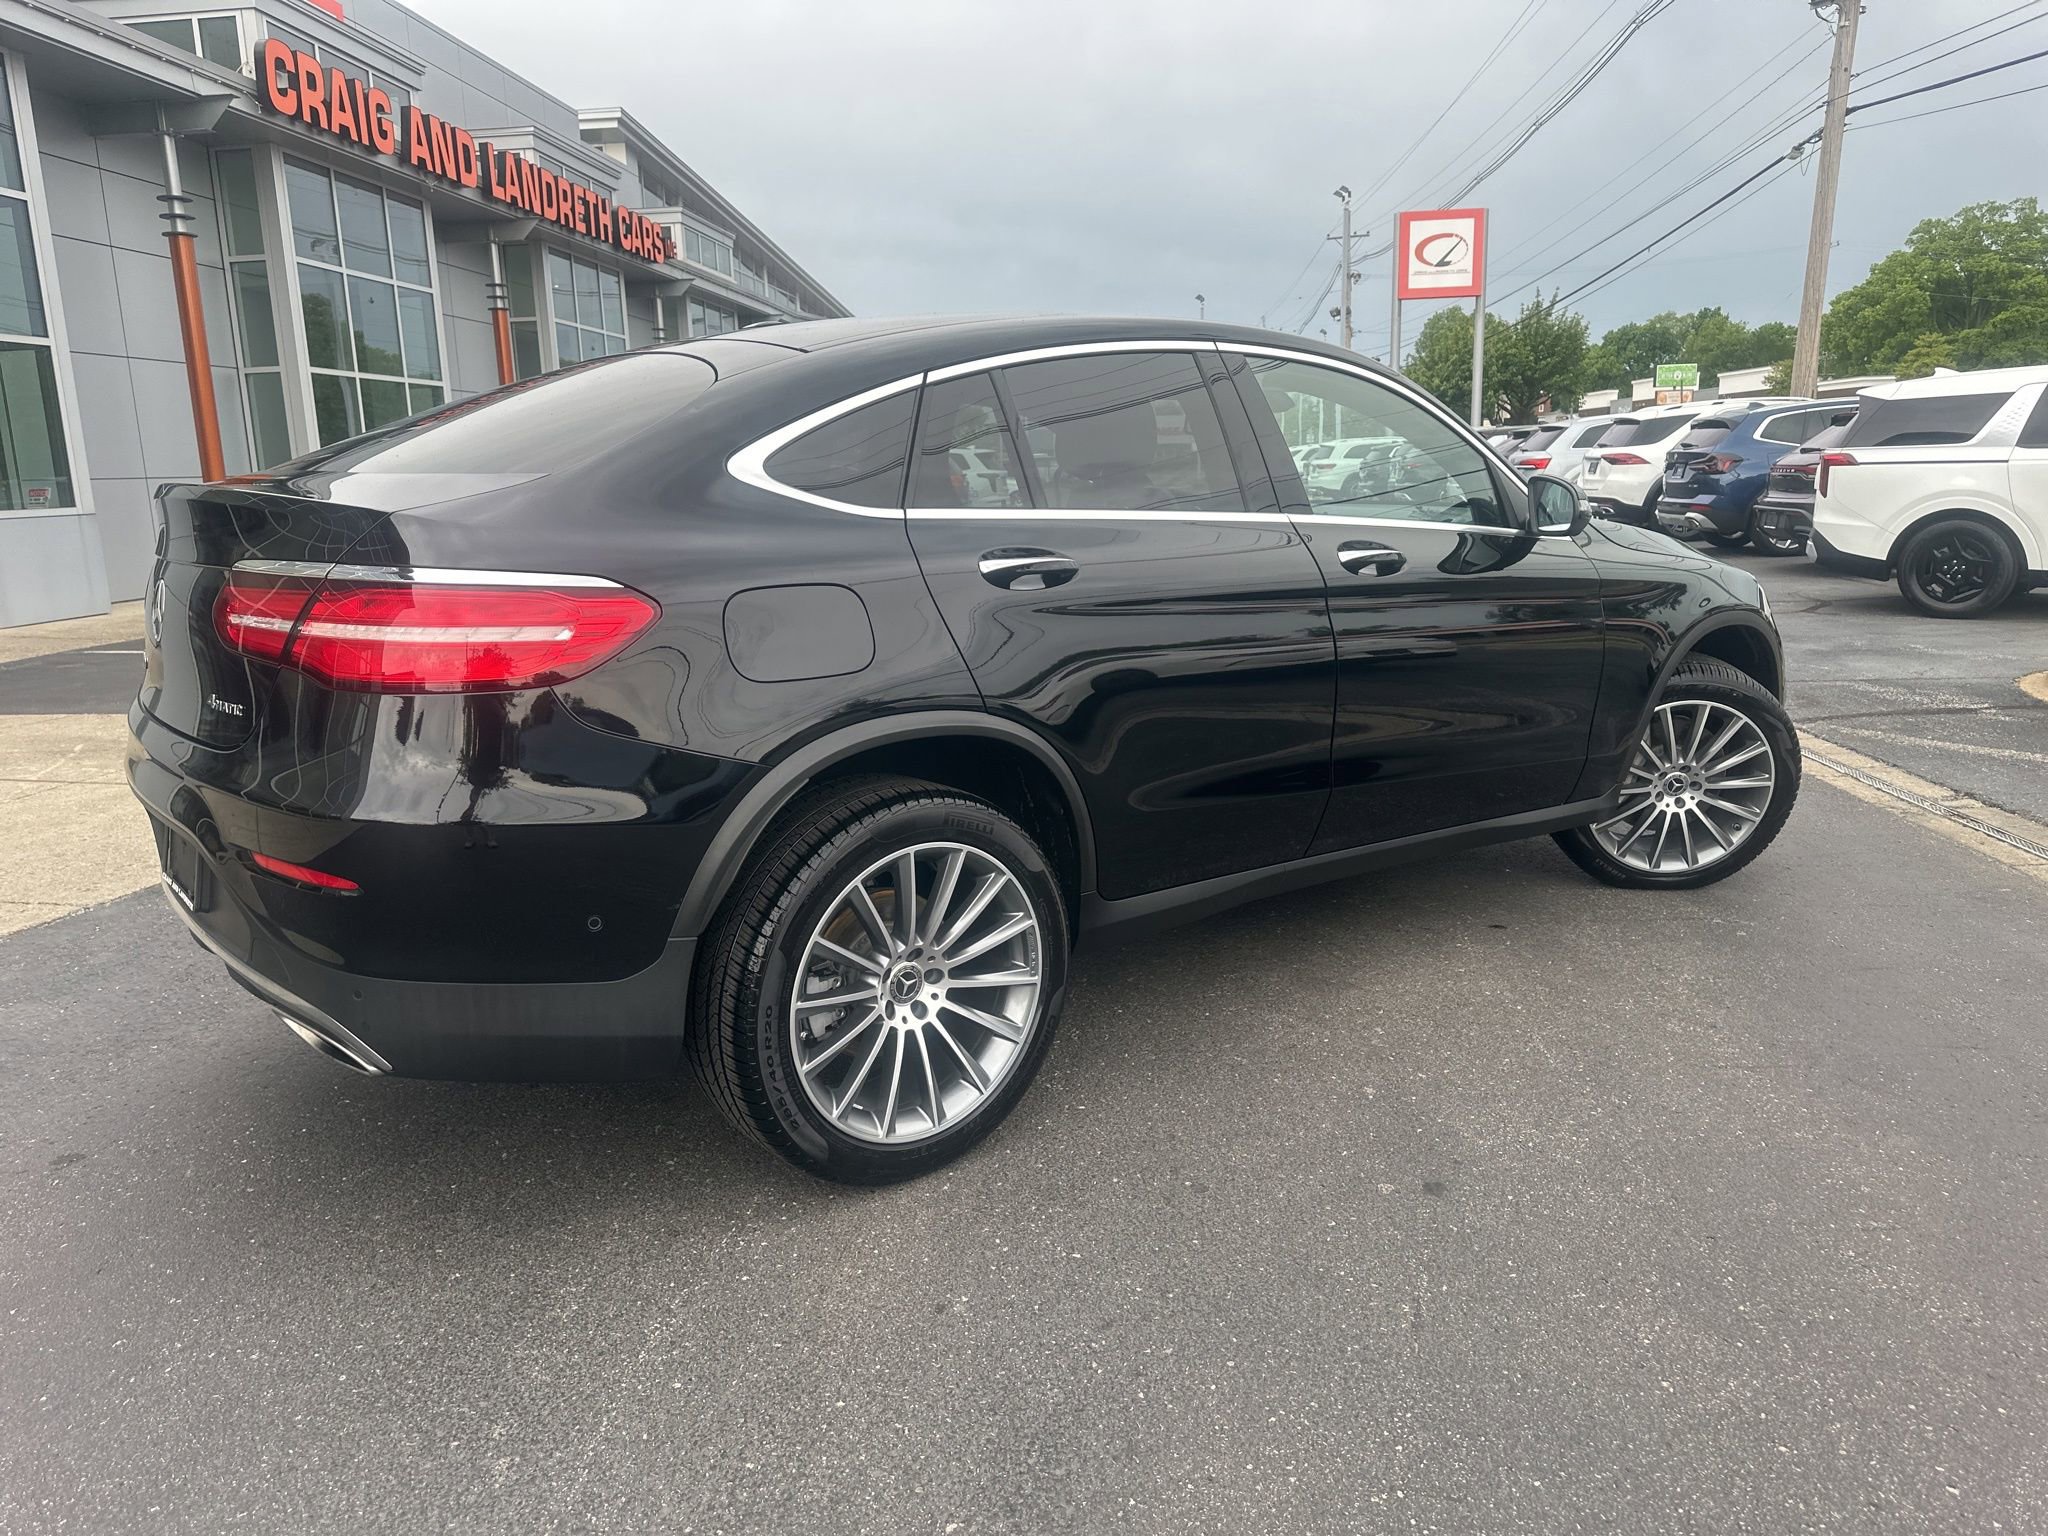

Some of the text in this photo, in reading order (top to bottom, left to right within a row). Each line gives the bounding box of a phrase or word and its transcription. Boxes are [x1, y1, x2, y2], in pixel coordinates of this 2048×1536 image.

[262, 37, 395, 155] CRAIG
[409, 104, 478, 188] AND
[487, 141, 614, 244] LANDRETH
[617, 204, 665, 264] CARS
[764, 1004, 774, 1051] R20
